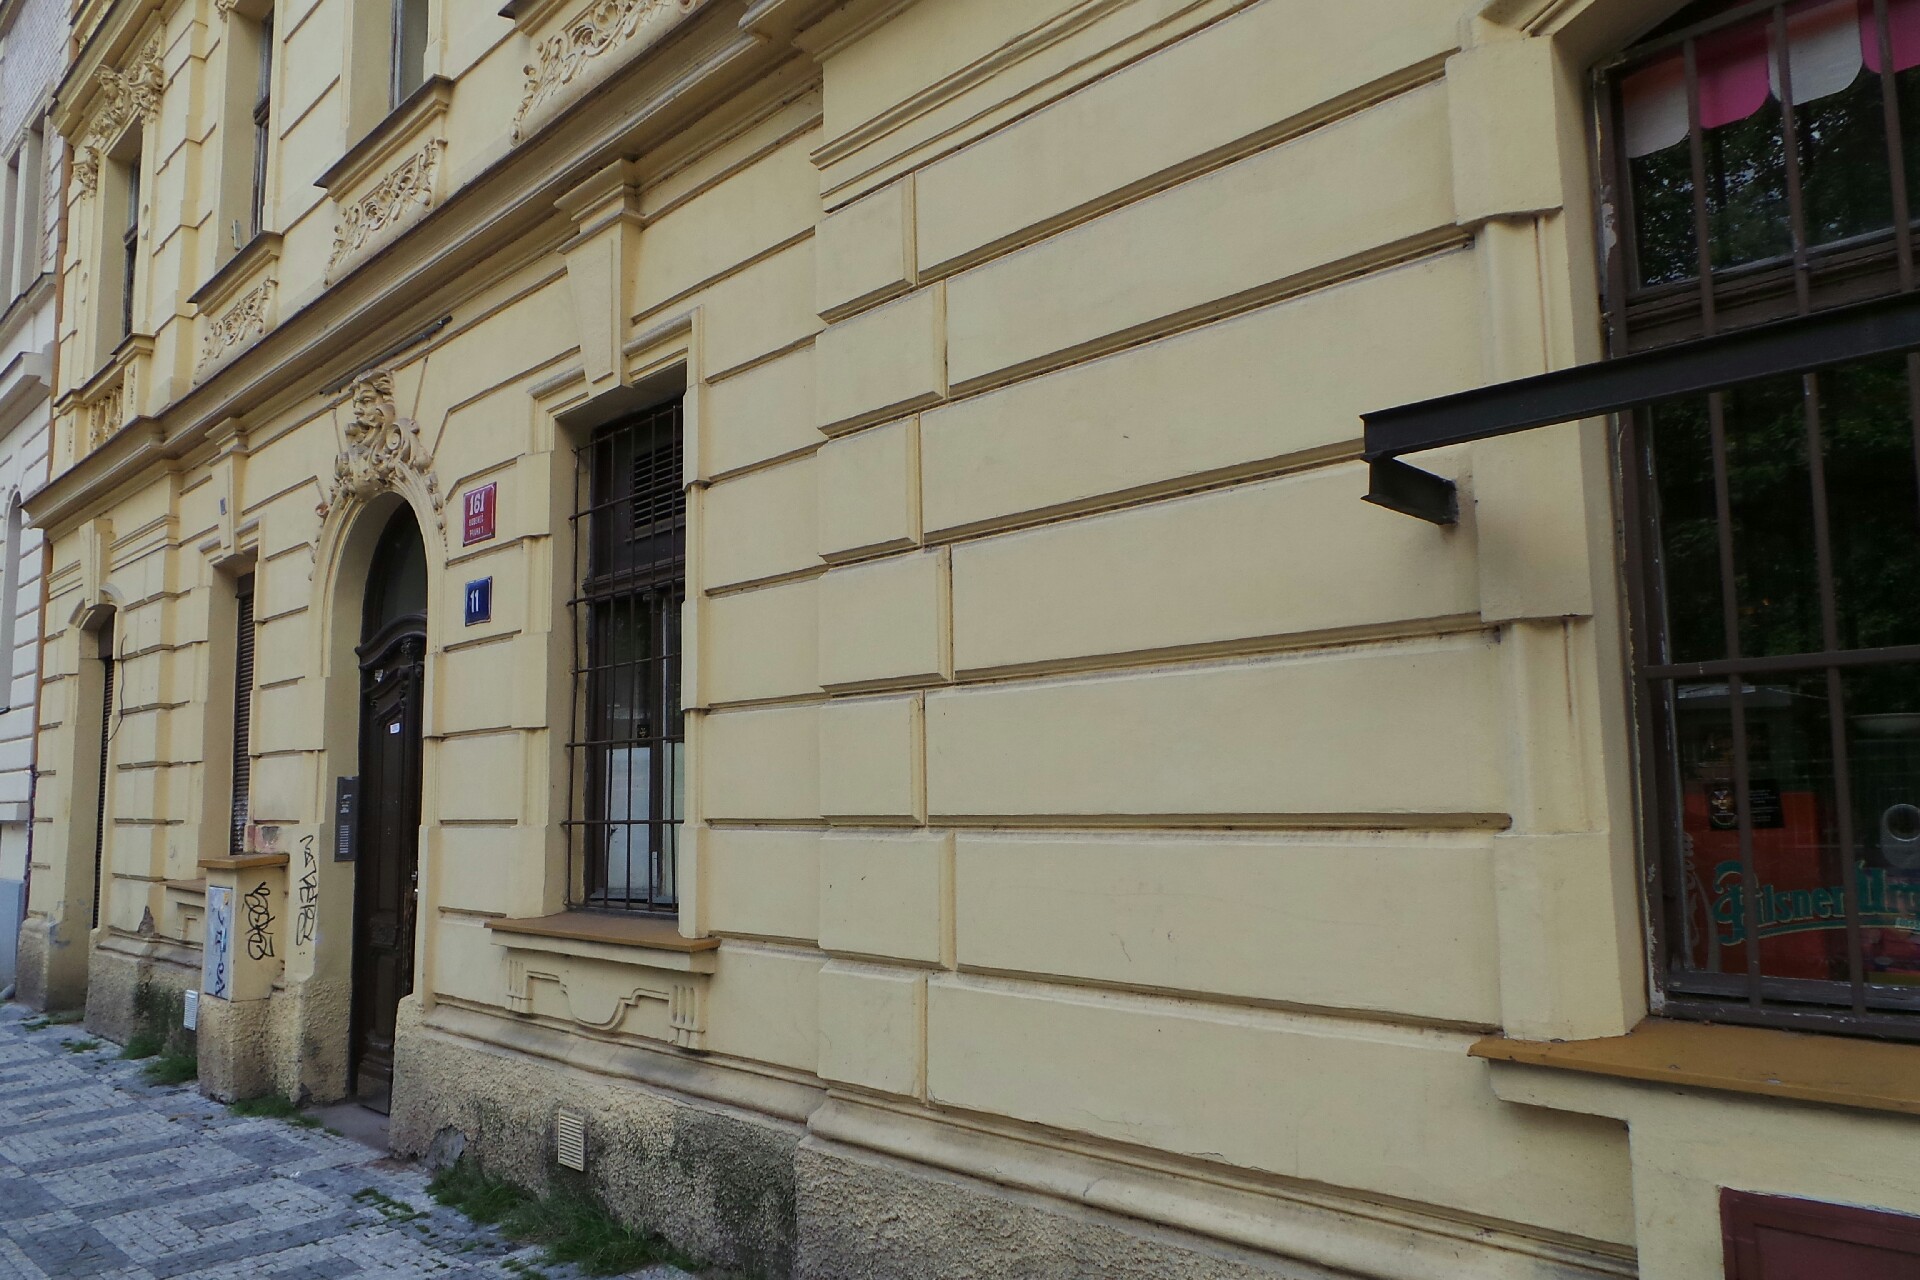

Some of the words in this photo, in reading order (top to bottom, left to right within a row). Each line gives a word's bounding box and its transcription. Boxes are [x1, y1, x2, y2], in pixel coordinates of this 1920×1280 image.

[469, 491, 485, 516] 161
[470, 589, 479, 613] 11
[1712, 860, 1848, 946] Pilsner
